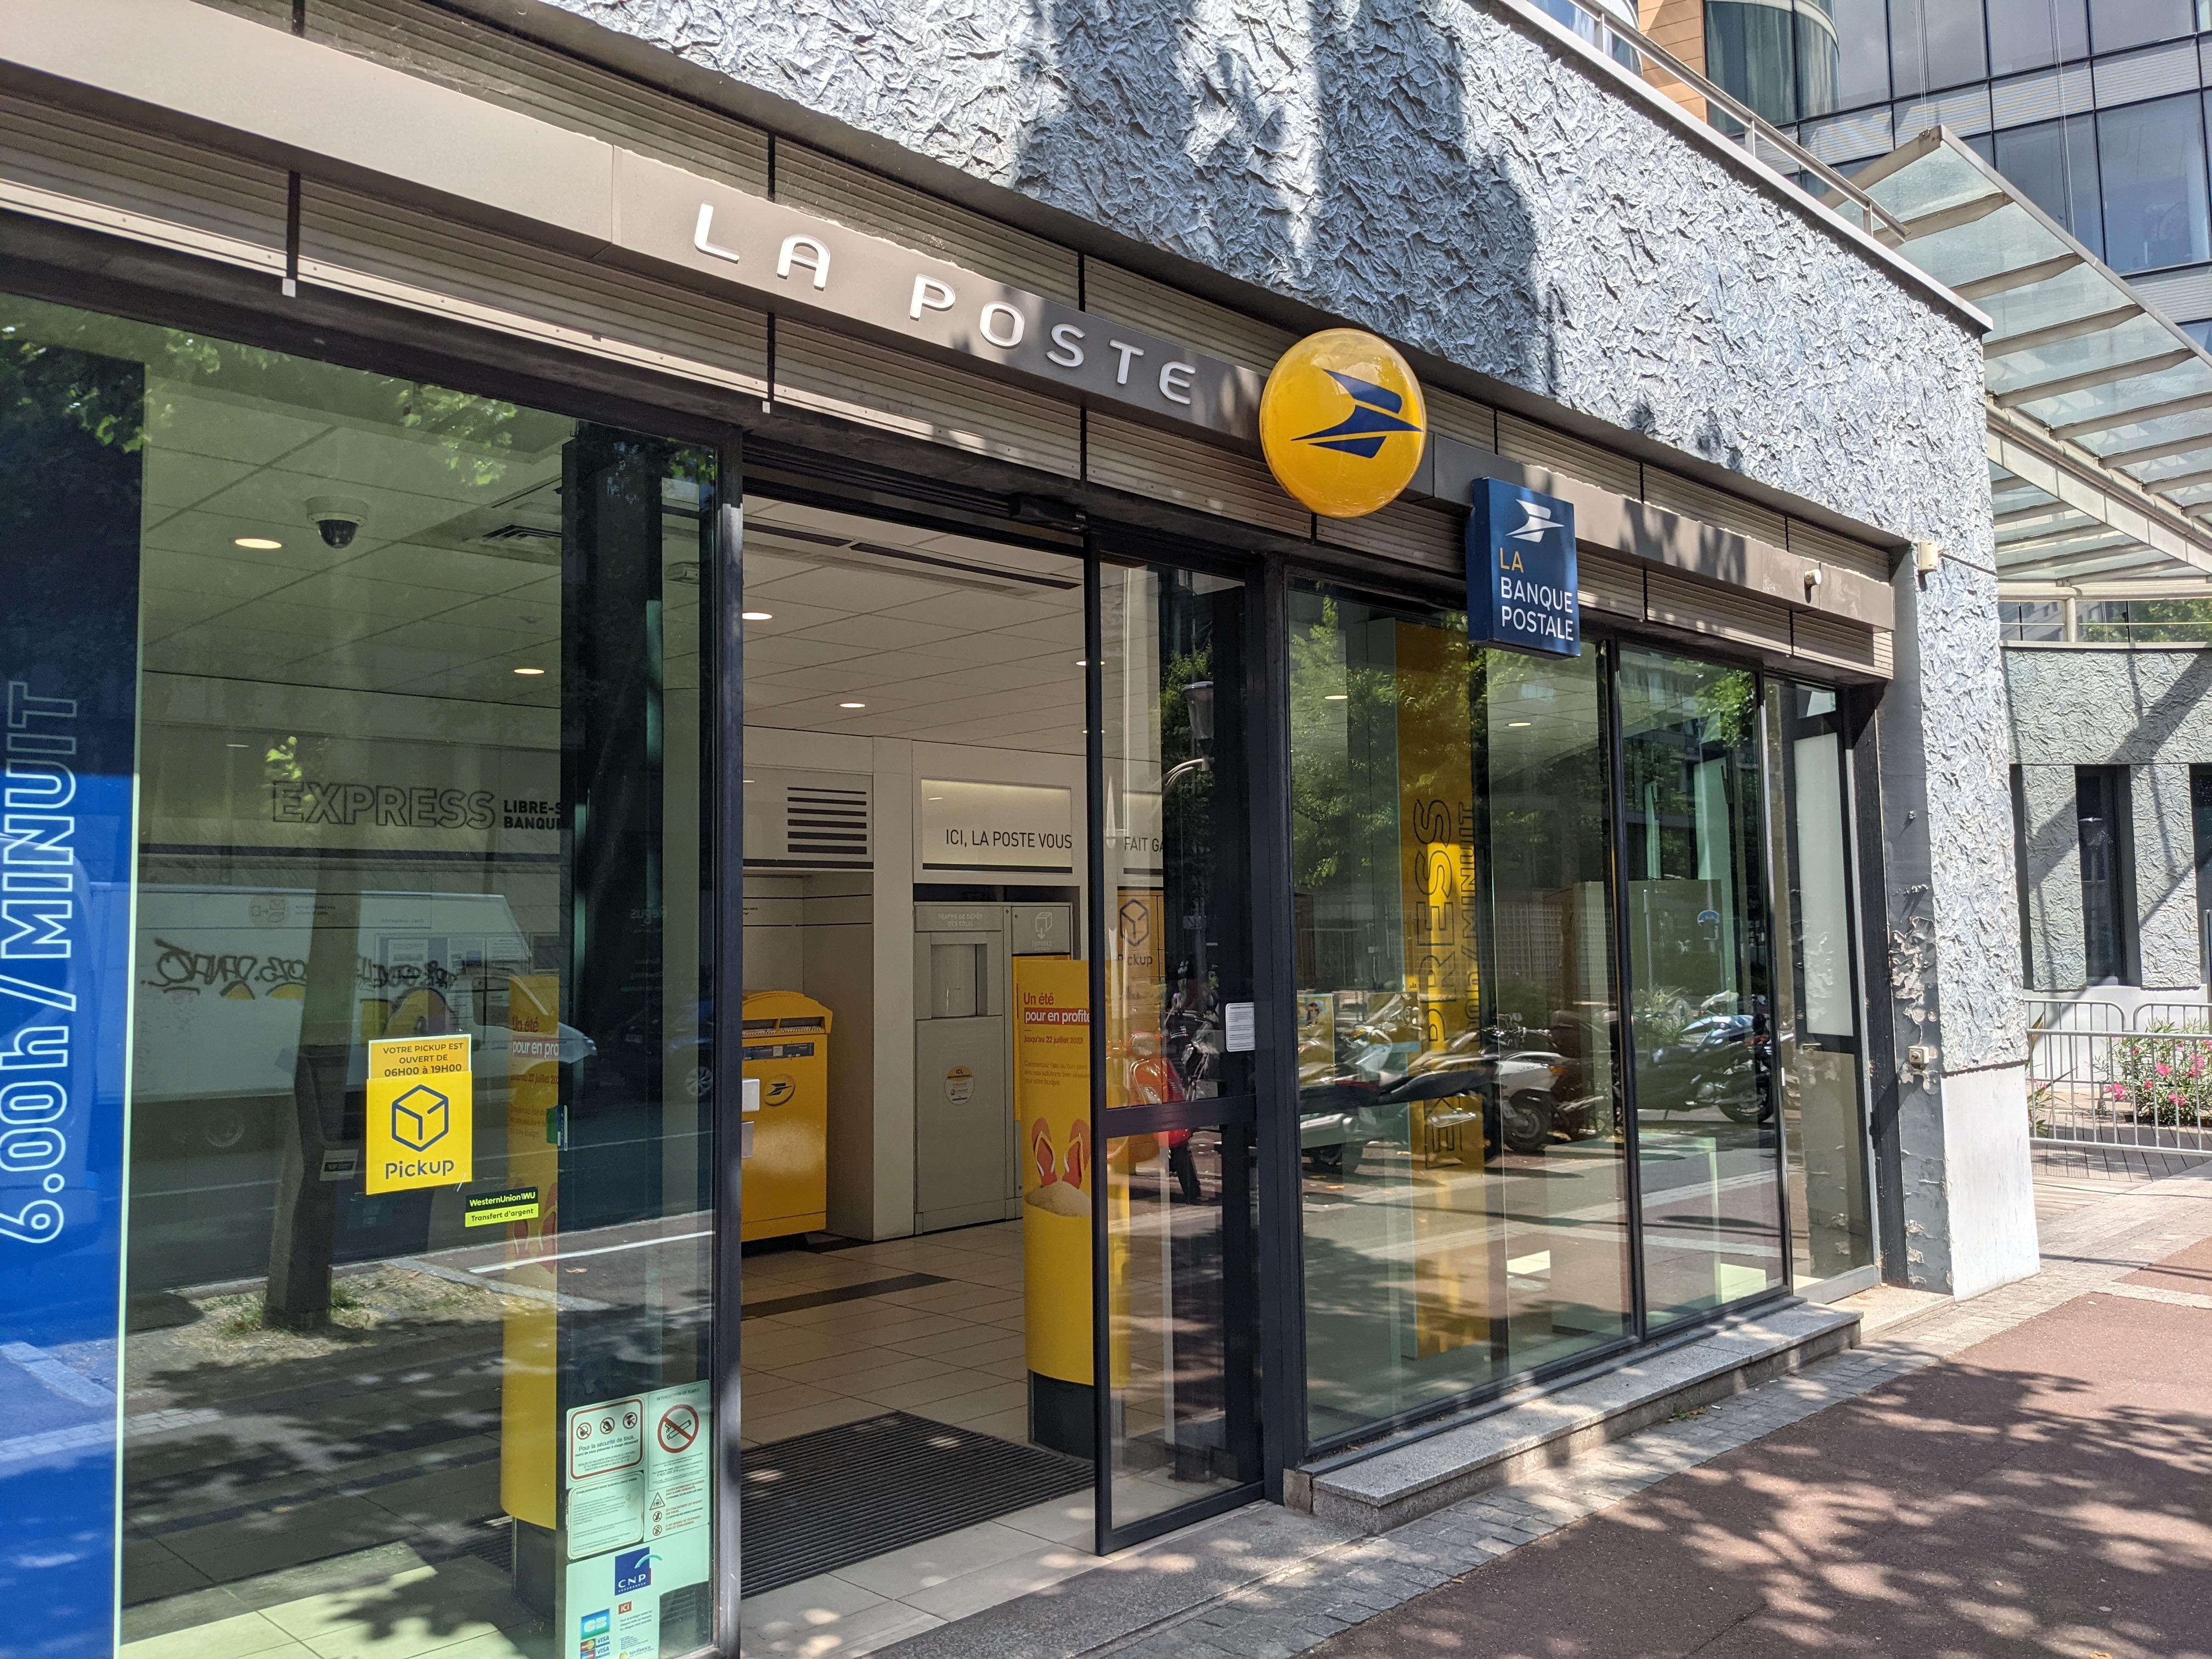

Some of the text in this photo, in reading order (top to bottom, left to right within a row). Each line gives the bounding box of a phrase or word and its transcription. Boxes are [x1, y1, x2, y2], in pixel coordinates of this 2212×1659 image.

[693, 200, 1197, 405] LA POSTE
[1499, 547, 1524, 573] LA
[1500, 576, 1573, 614] BANQUE
[1502, 605, 1573, 641] POSTALE
[272, 780, 495, 830] EXPRESS
[0, 681, 77, 959] MINUIT
[946, 829, 967, 848] ICI,
[972, 830, 989, 847] LA
[993, 831, 1035, 848] POSTE
[1039, 833, 1073, 849] VOUS
[1124, 837, 1148, 851] FAIT
[1118, 953, 1153, 967] Pckup
[1024, 992, 1054, 1005] Un été
[525, 1015, 539, 1032] été
[1025, 1011, 1046, 1024] pour
[1047, 1012, 1059, 1022] en
[1024, 1035, 1045, 1043] jusqu'au
[1053, 1036, 1068, 1045] juillet
[415, 1043, 447, 1052] PICKUP
[512, 1041, 531, 1056] pour
[531, 1042, 542, 1054] en
[399, 1056, 435, 1064] OUVERT
[384, 1063, 462, 1077] 06H00 à 19H00
[386, 1159, 455, 1180] Pickup
[469, 1194, 521, 1207] WesternUnion
[471, 1208, 534, 1222] Transfert d'argent
[597, 1439, 616, 1447] sécurité
[618, 1573, 646, 1588] CNP
[620, 1603, 629, 1612] ICI
[597, 1635, 610, 1644] VISA
[597, 1646, 610, 1655] VISA
